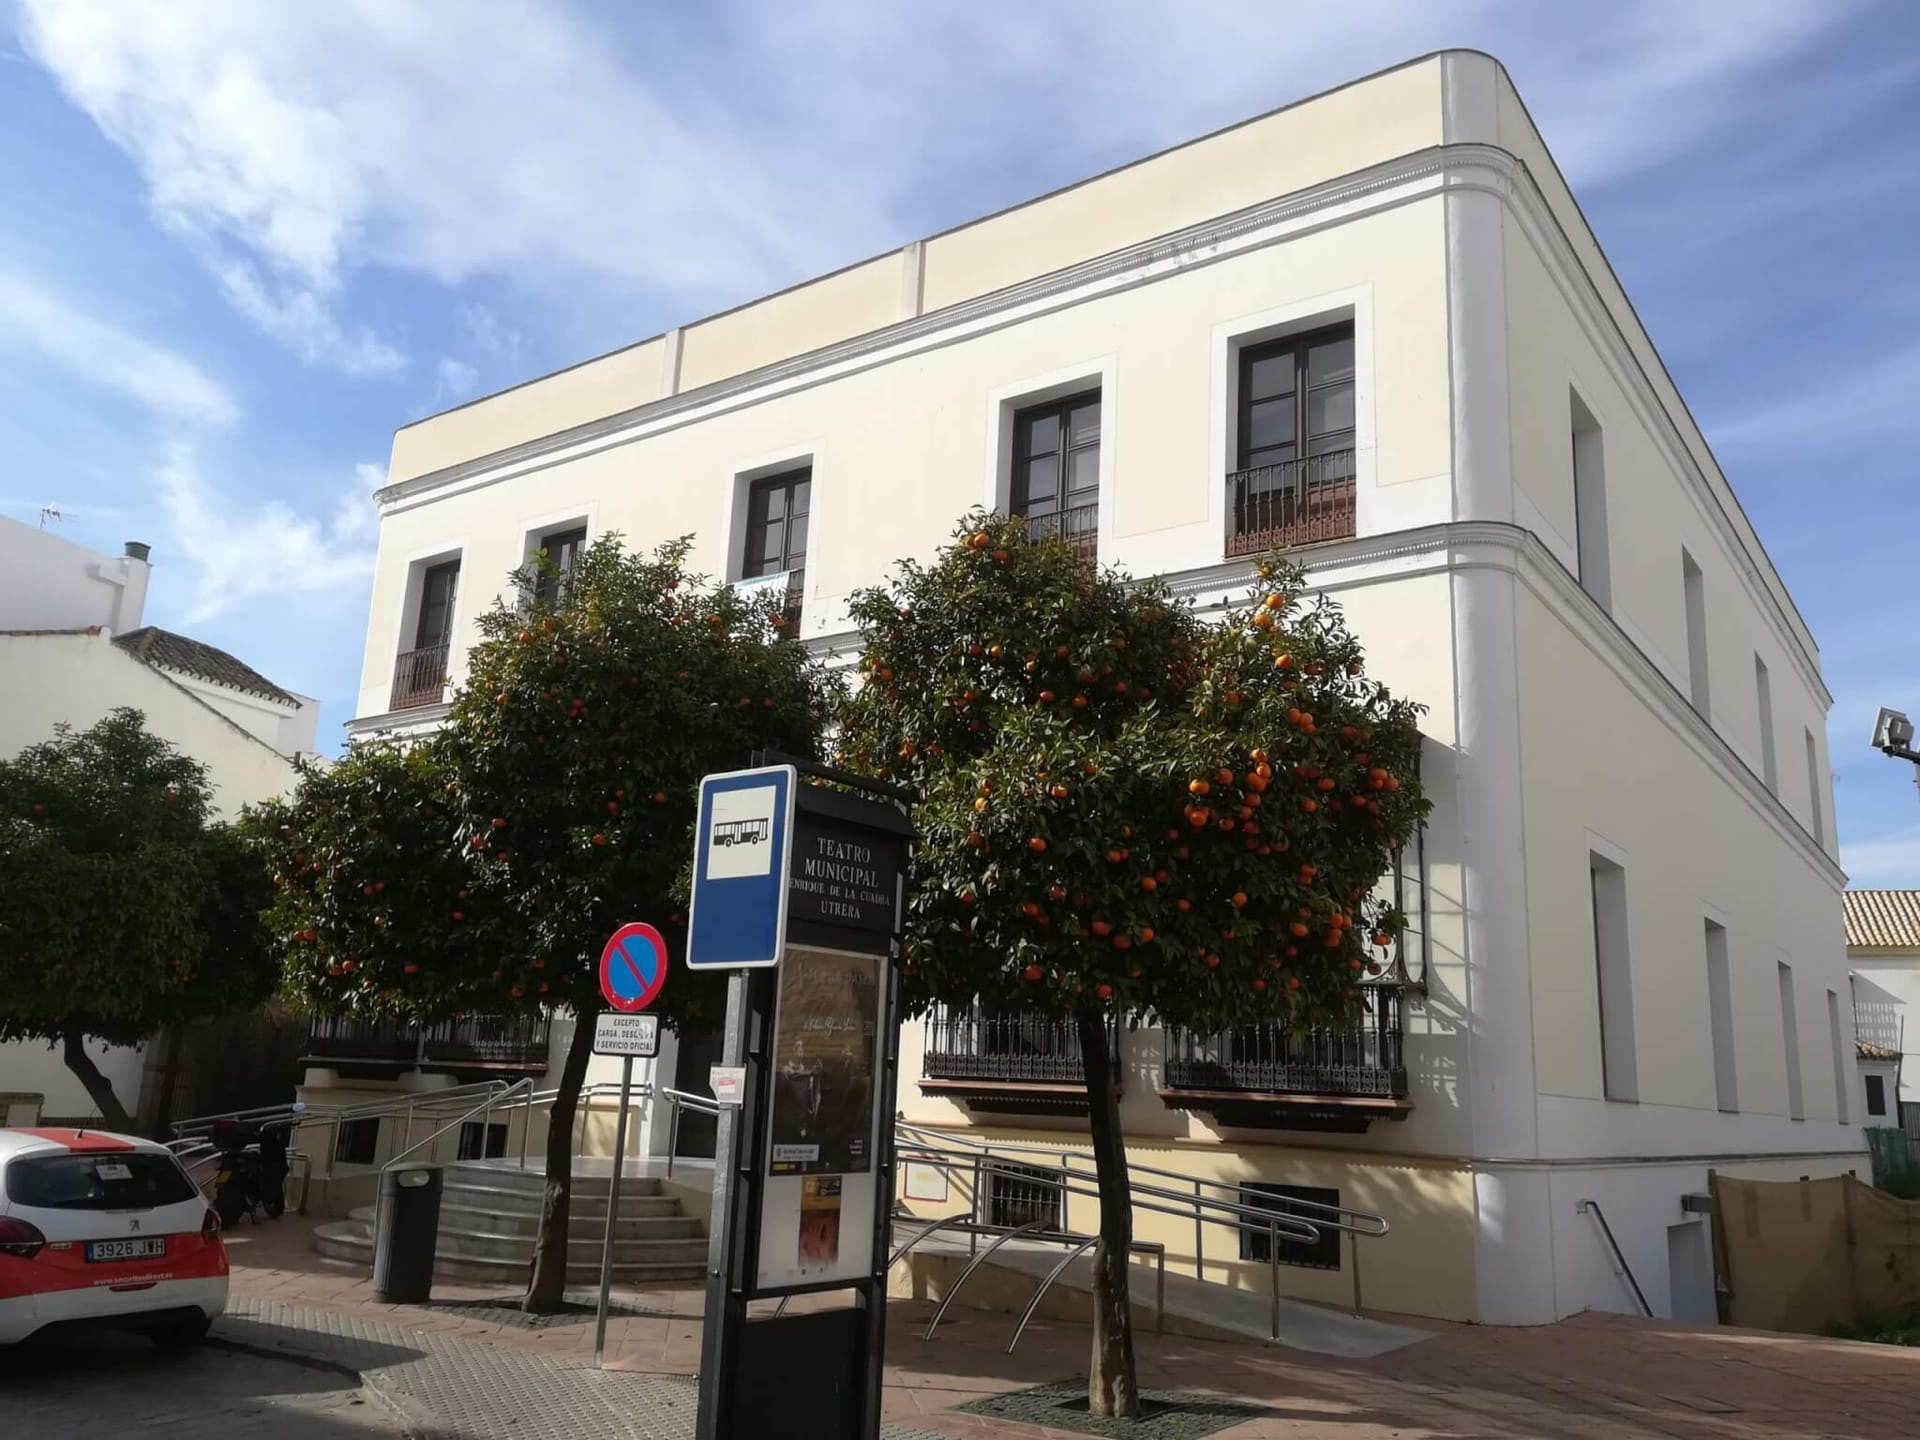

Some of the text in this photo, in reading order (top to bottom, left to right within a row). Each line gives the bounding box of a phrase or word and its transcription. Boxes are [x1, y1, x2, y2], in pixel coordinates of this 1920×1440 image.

[817, 837, 871, 863] TEATRO
[804, 858, 879, 888] MUNICIPAL
[789, 878, 825, 894] ENRIQUE
[829, 884, 841, 897] DE
[844, 887, 856, 900] LA
[820, 900, 861, 919] UTRERA
[613, 1018, 640, 1027] EXCEPTO
[596, 1040, 653, 1051] Y SERVICIO OFICIAL
[96, 1239, 164, 1258] 3926 JWH
